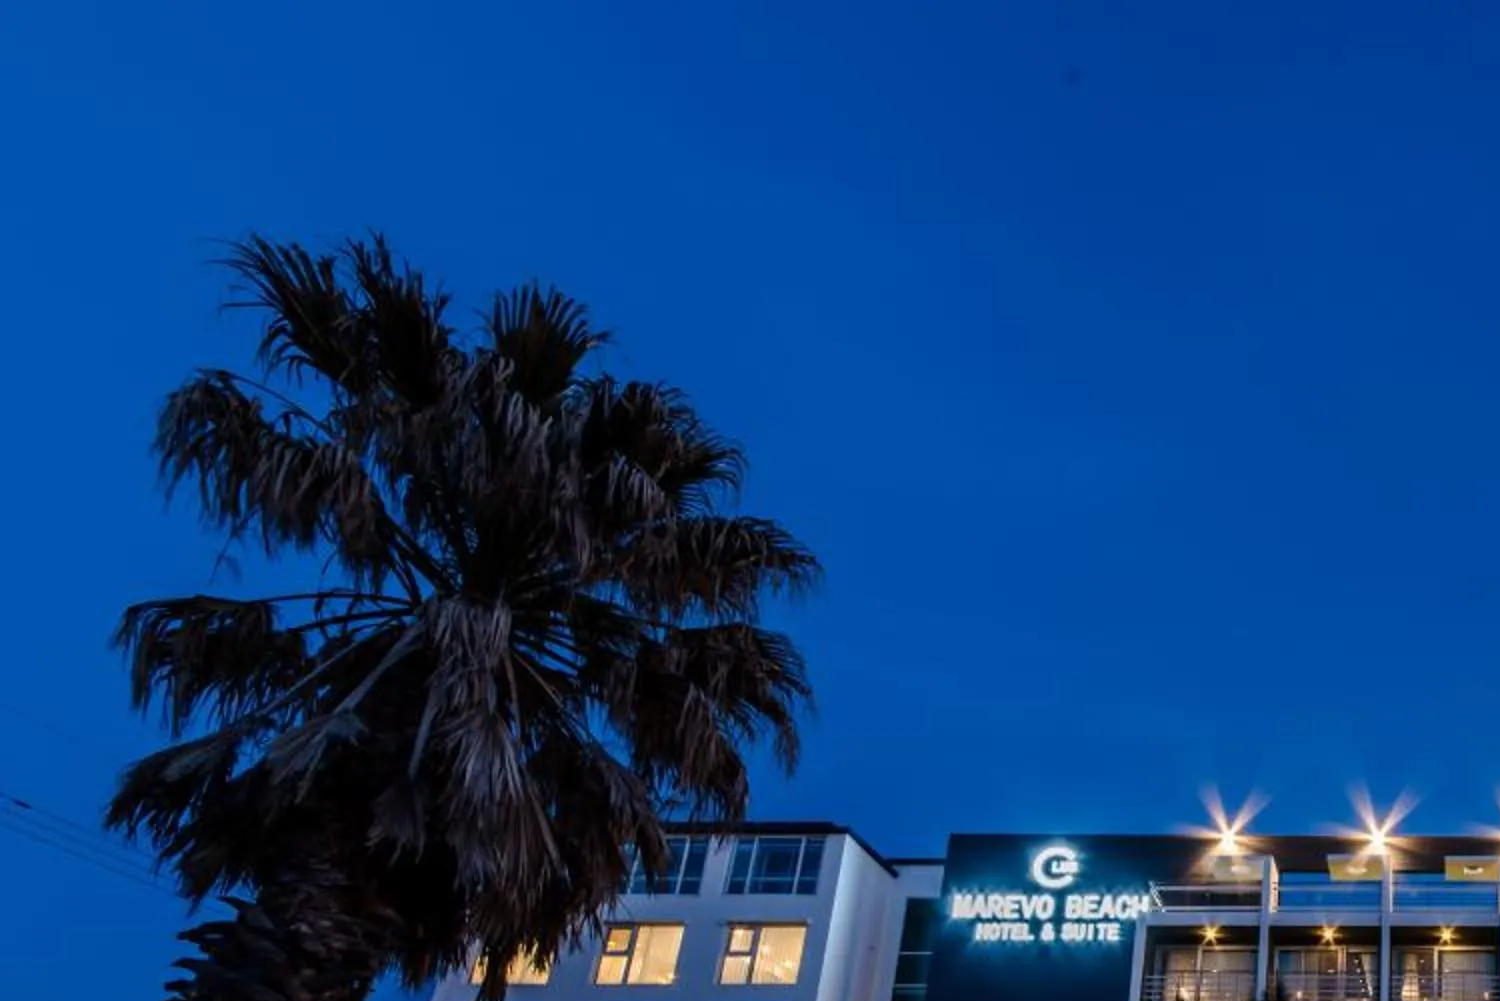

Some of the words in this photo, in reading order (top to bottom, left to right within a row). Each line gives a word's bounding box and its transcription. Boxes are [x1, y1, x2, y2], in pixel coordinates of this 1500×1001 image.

[952, 893, 1055, 919] MAREVO
[1064, 893, 1149, 919] BEACH
[975, 923, 1034, 942] HOTEL
[1040, 923, 1055, 941] &
[1060, 923, 1121, 941] SUITE
